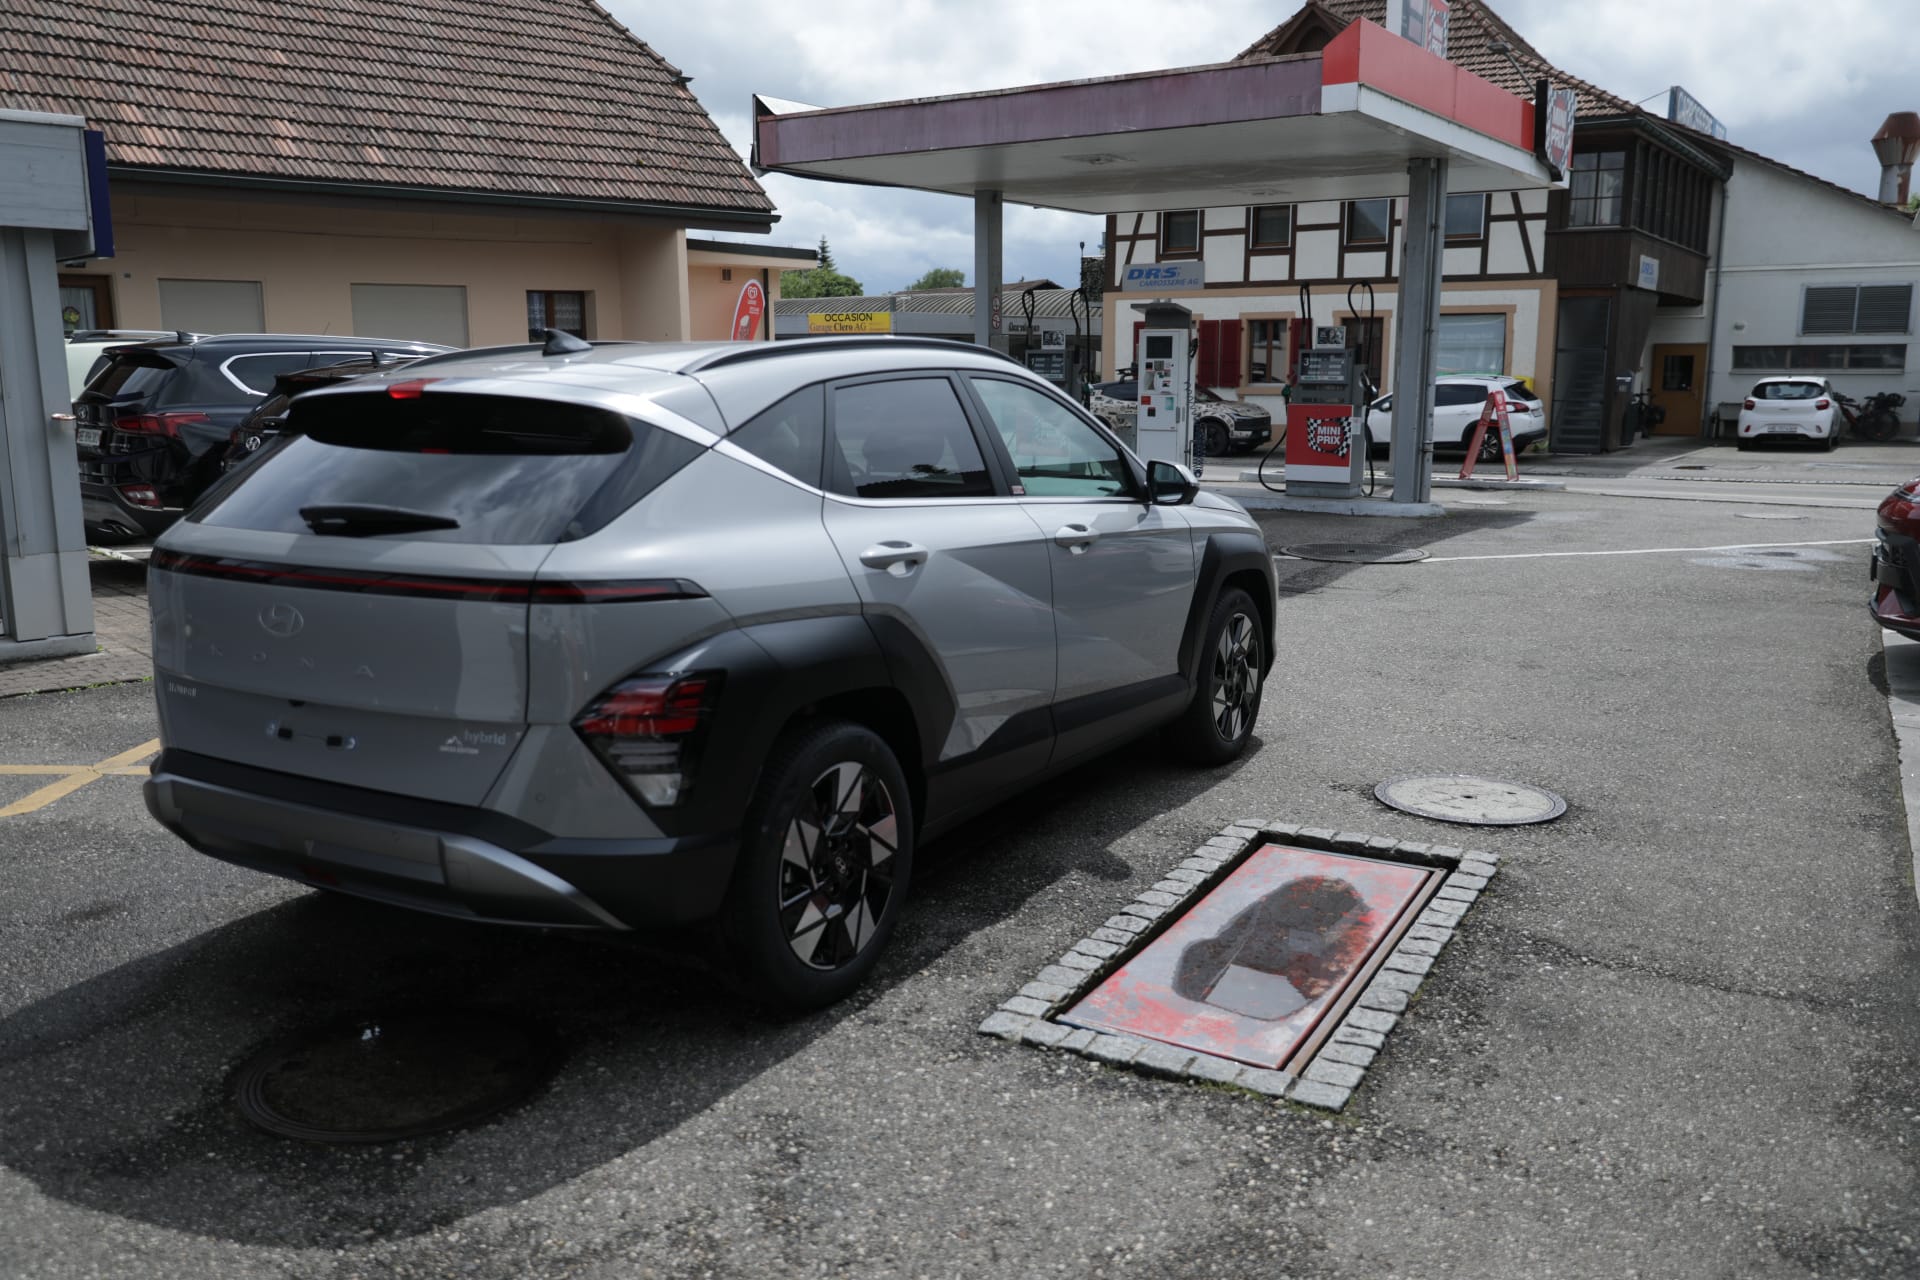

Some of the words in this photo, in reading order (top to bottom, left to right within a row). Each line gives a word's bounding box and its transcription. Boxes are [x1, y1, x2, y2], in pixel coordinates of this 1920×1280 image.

[1127, 267, 1179, 280] DRS
[825, 313, 873, 322] OCCASION
[1303, 357, 1310, 366] 3
[1317, 426, 1342, 435] MINI
[1316, 435, 1342, 445] PRIX
[464, 729, 507, 746] hybrid
